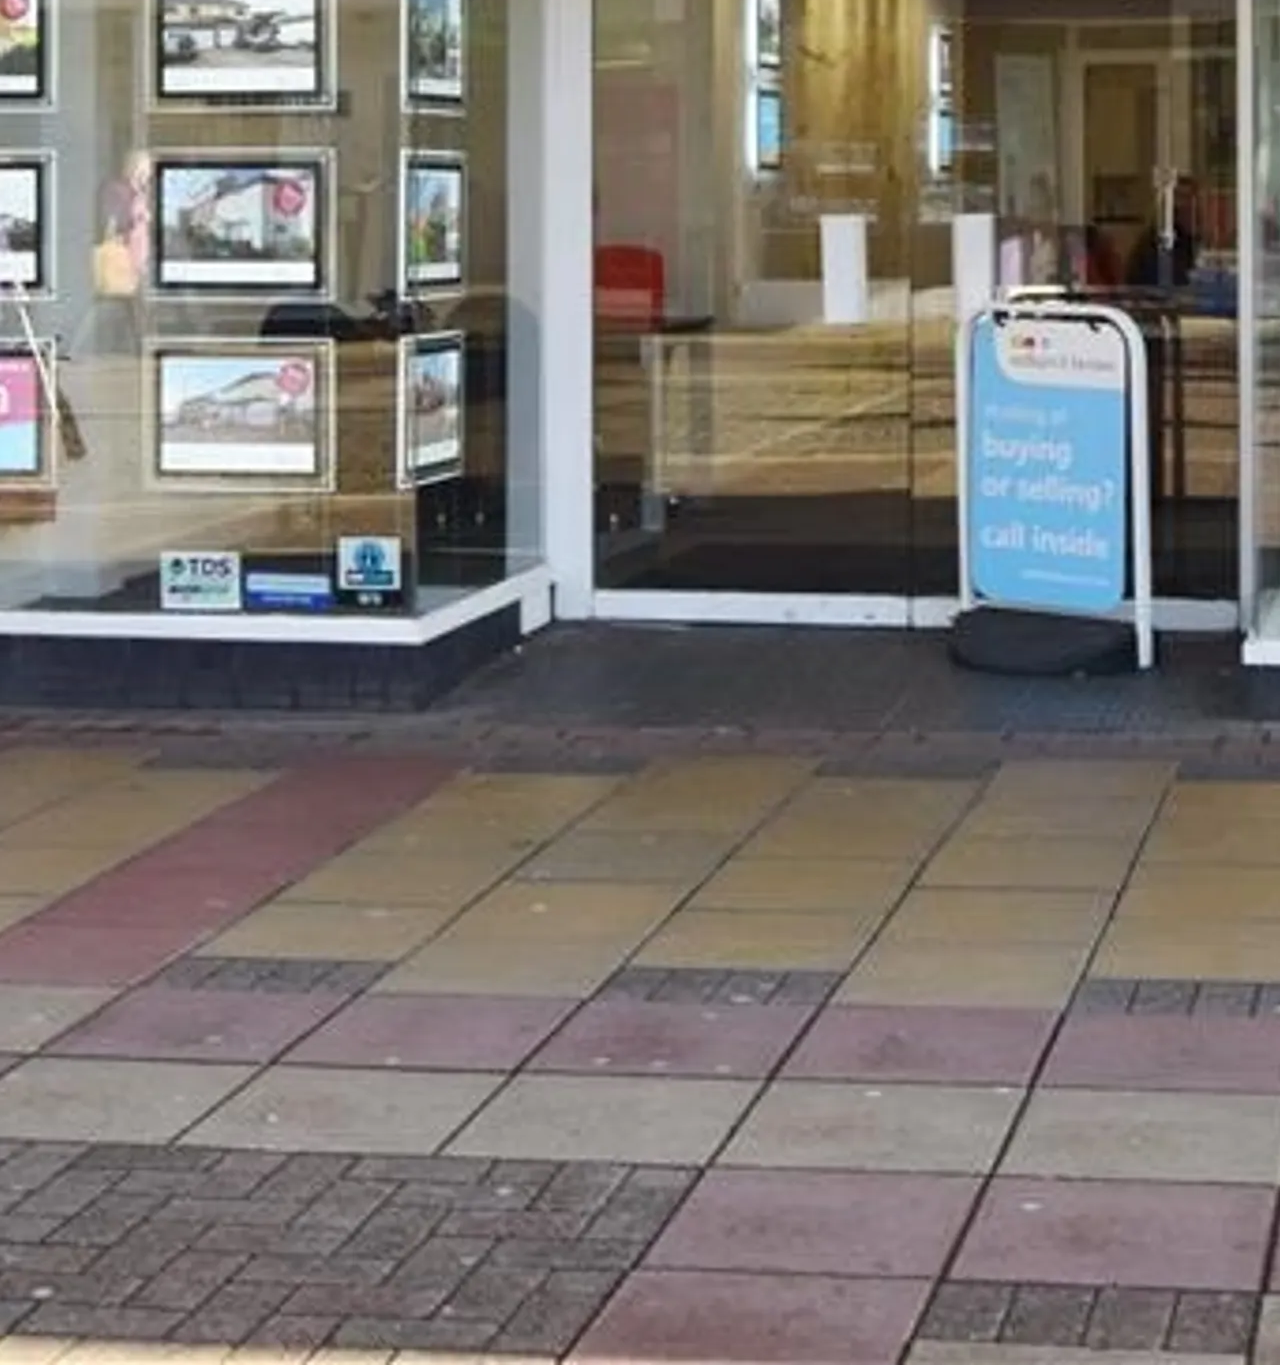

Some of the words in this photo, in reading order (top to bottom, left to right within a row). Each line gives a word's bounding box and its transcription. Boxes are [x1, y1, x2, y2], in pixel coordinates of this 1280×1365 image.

[981, 429, 1072, 471] buying
[1017, 475, 1114, 514] selling?
[188, 557, 234, 578] TDS
